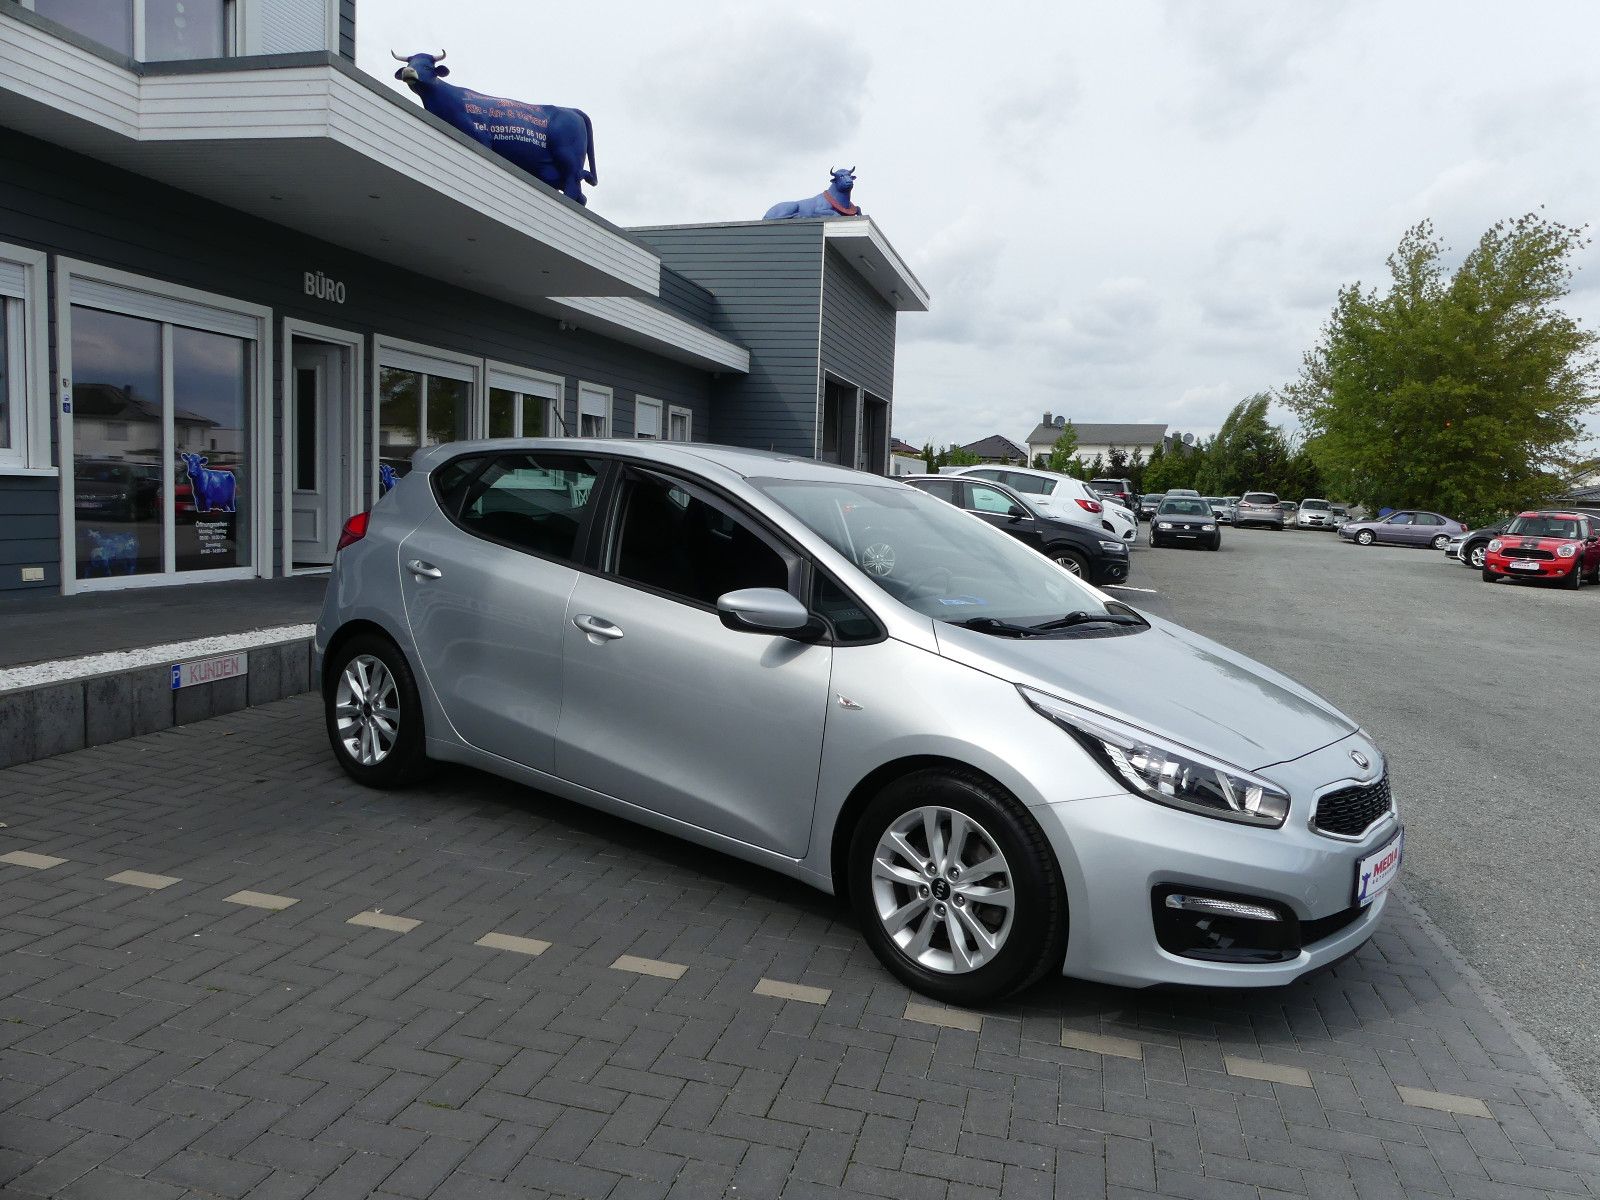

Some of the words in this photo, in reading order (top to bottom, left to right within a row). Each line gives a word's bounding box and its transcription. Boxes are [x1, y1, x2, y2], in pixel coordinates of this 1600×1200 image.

[473, 122, 488, 131] Tel.
[490, 125, 525, 134] 0391/597
[536, 132, 547, 141] 100
[304, 270, 346, 304] BÜRO
[172, 670, 180, 684] P
[189, 656, 239, 684] KUNDEN
[1373, 847, 1398, 878] MEDIA
[935, 880, 946, 898] KIA
